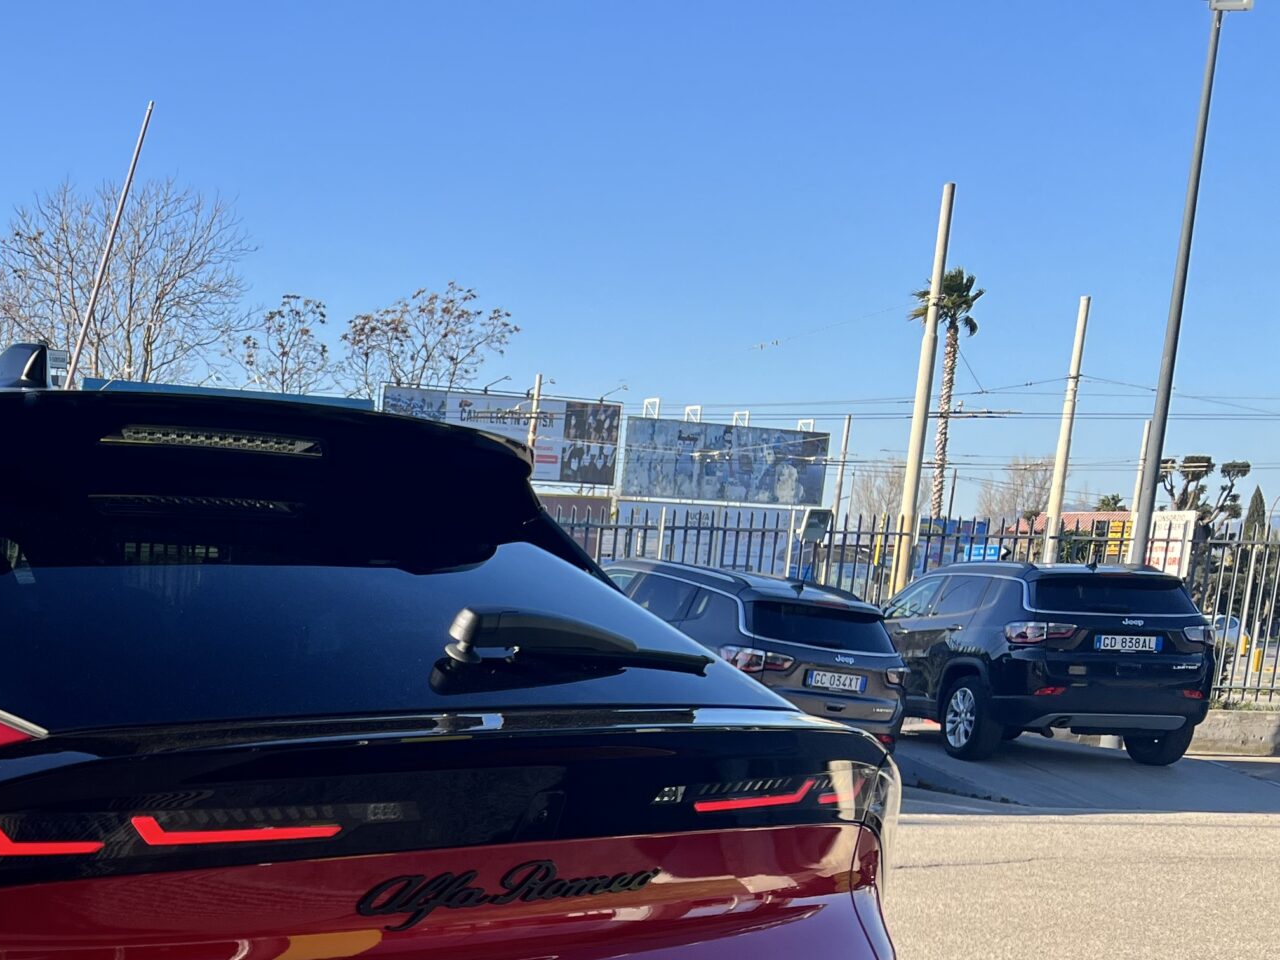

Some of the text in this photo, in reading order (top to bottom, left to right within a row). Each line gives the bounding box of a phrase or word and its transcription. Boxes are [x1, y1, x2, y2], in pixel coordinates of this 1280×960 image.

[1122, 618, 1144, 627] Jeep
[1103, 637, 1154, 649] GD 838AL
[835, 655, 855, 665] Jeep
[814, 672, 860, 691] GC 034XT
[356, 859, 662, 932] Alfa Romeo
